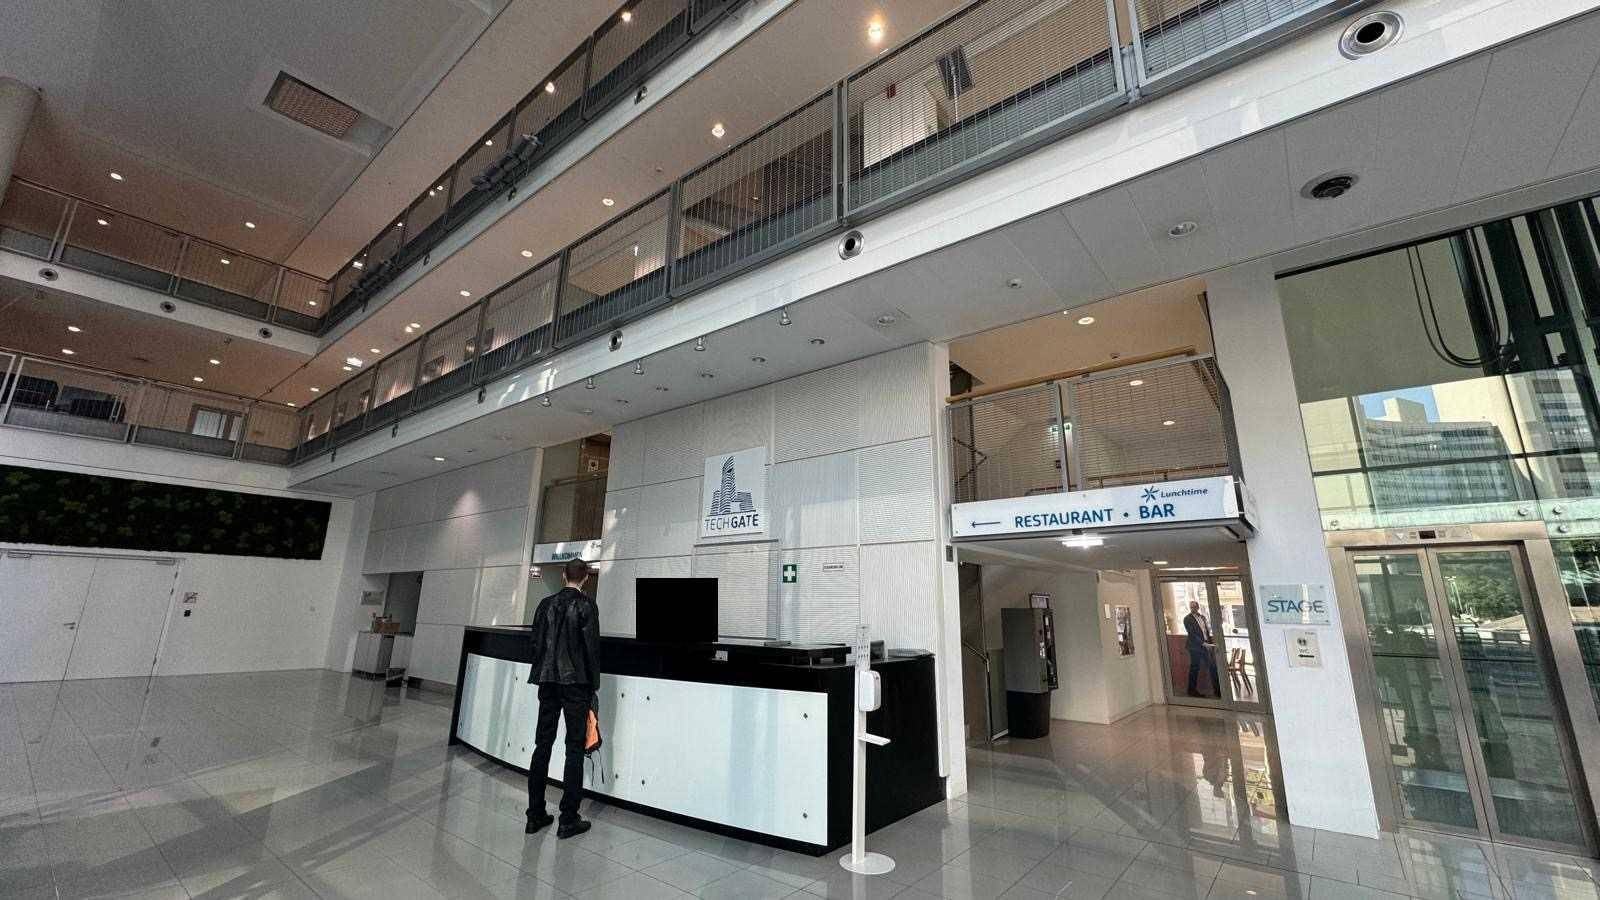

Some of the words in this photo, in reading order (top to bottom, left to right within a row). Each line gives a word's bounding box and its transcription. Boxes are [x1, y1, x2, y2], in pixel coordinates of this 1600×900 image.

[1160, 487, 1209, 498] Lunchtime
[1014, 508, 1114, 528] RESTAURANT
[1139, 503, 1176, 519] BAR
[1267, 599, 1325, 613] STAGE
